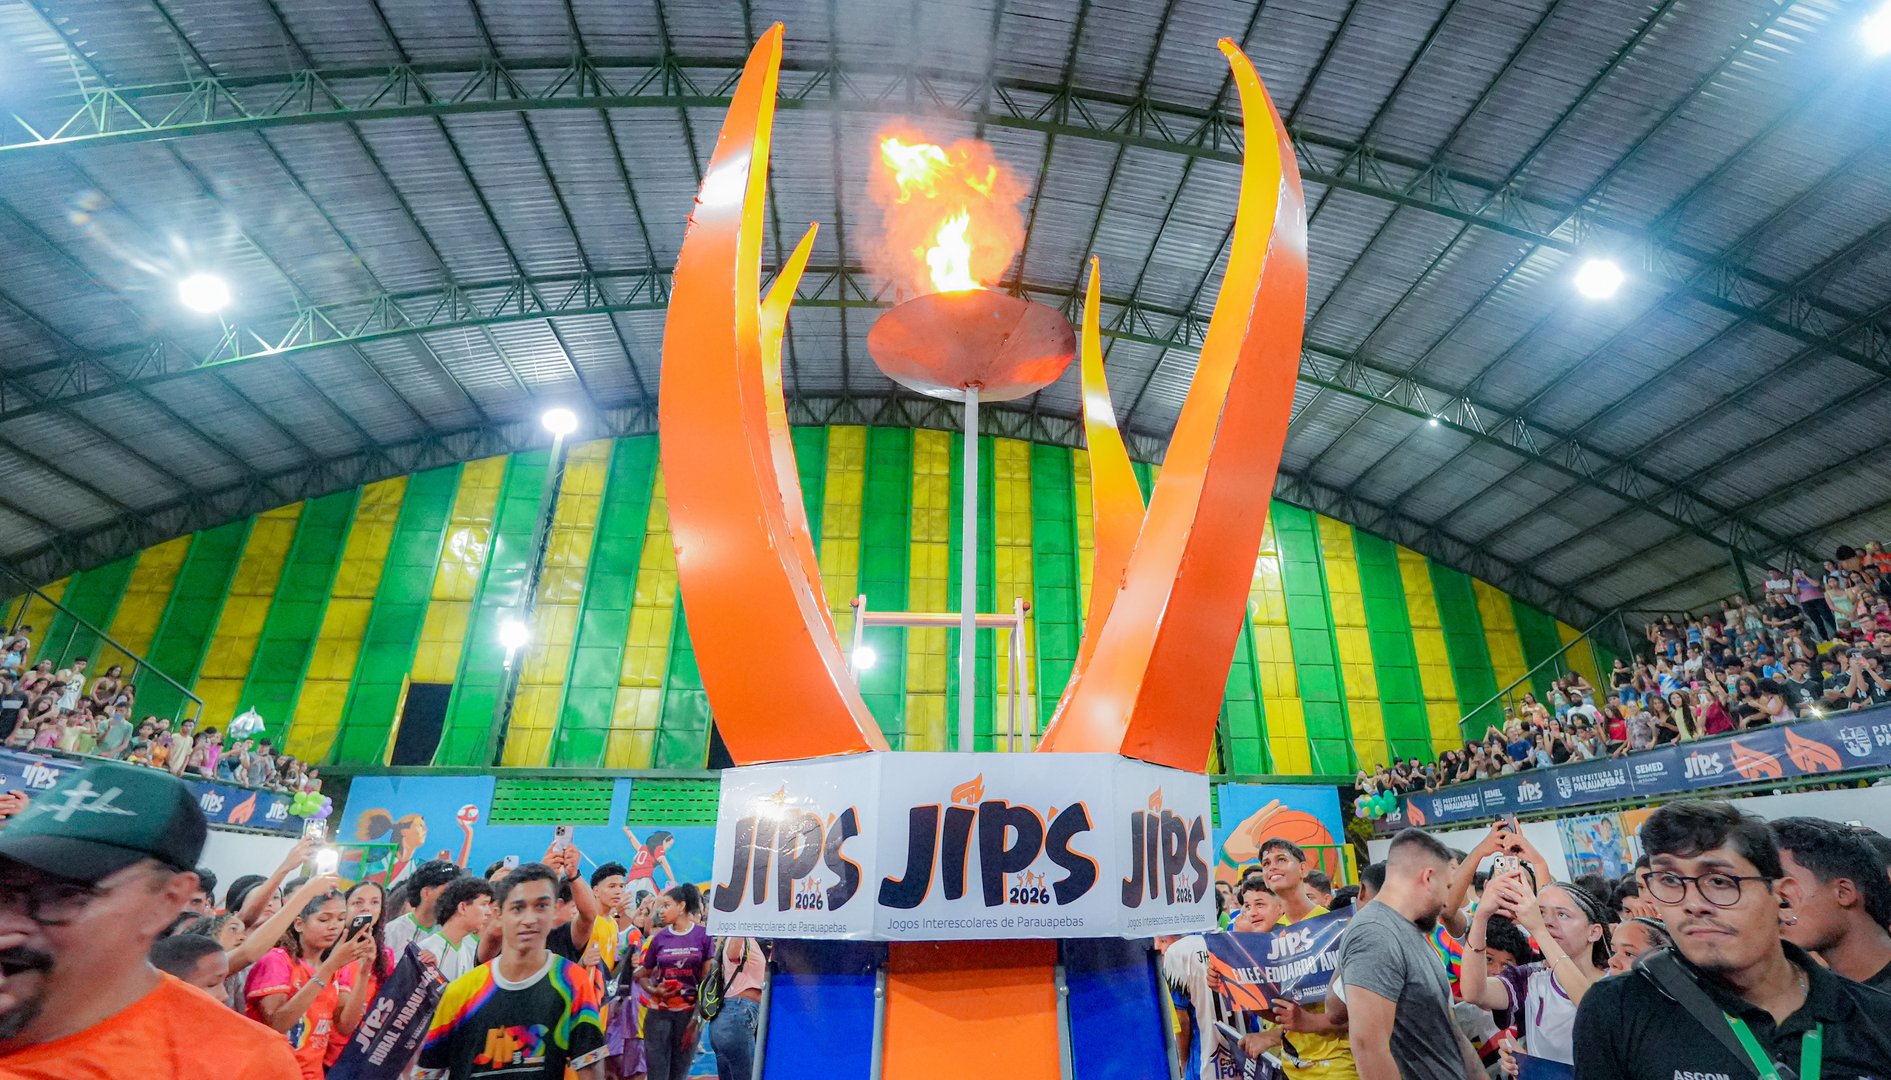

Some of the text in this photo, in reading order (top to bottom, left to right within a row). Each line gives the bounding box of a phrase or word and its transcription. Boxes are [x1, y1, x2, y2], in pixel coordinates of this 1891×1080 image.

[1635, 762, 1664, 775] SEMED
[1684, 752, 1724, 778] JIPS
[1571, 770, 1612, 783] PREFEITURA
[1614, 768, 1624, 777] DE
[1573, 775, 1626, 792] PARAUAPEBAS
[1517, 782, 1543, 803] JIPS
[265, 802, 290, 820] JIPS
[713, 805, 863, 913] JIPS
[878, 799, 1100, 910] JIPS
[1121, 809, 1208, 908] JIPS
[795, 893, 823, 911] 2026
[1009, 888, 1050, 905] 2026
[1176, 888, 1192, 903] 2026
[717, 921, 847, 934] Jogos Interescolares de Parauapebas
[888, 916, 1084, 932] Jogos Interescolares de Parauapebas
[1267, 927, 1316, 960] JIPS
[1265, 955, 1318, 983] EDUARDO
[355, 997, 394, 1054] JIPS
[368, 1031, 401, 1066] RURAL
[1673, 1069, 1730, 1080] ASCOM
